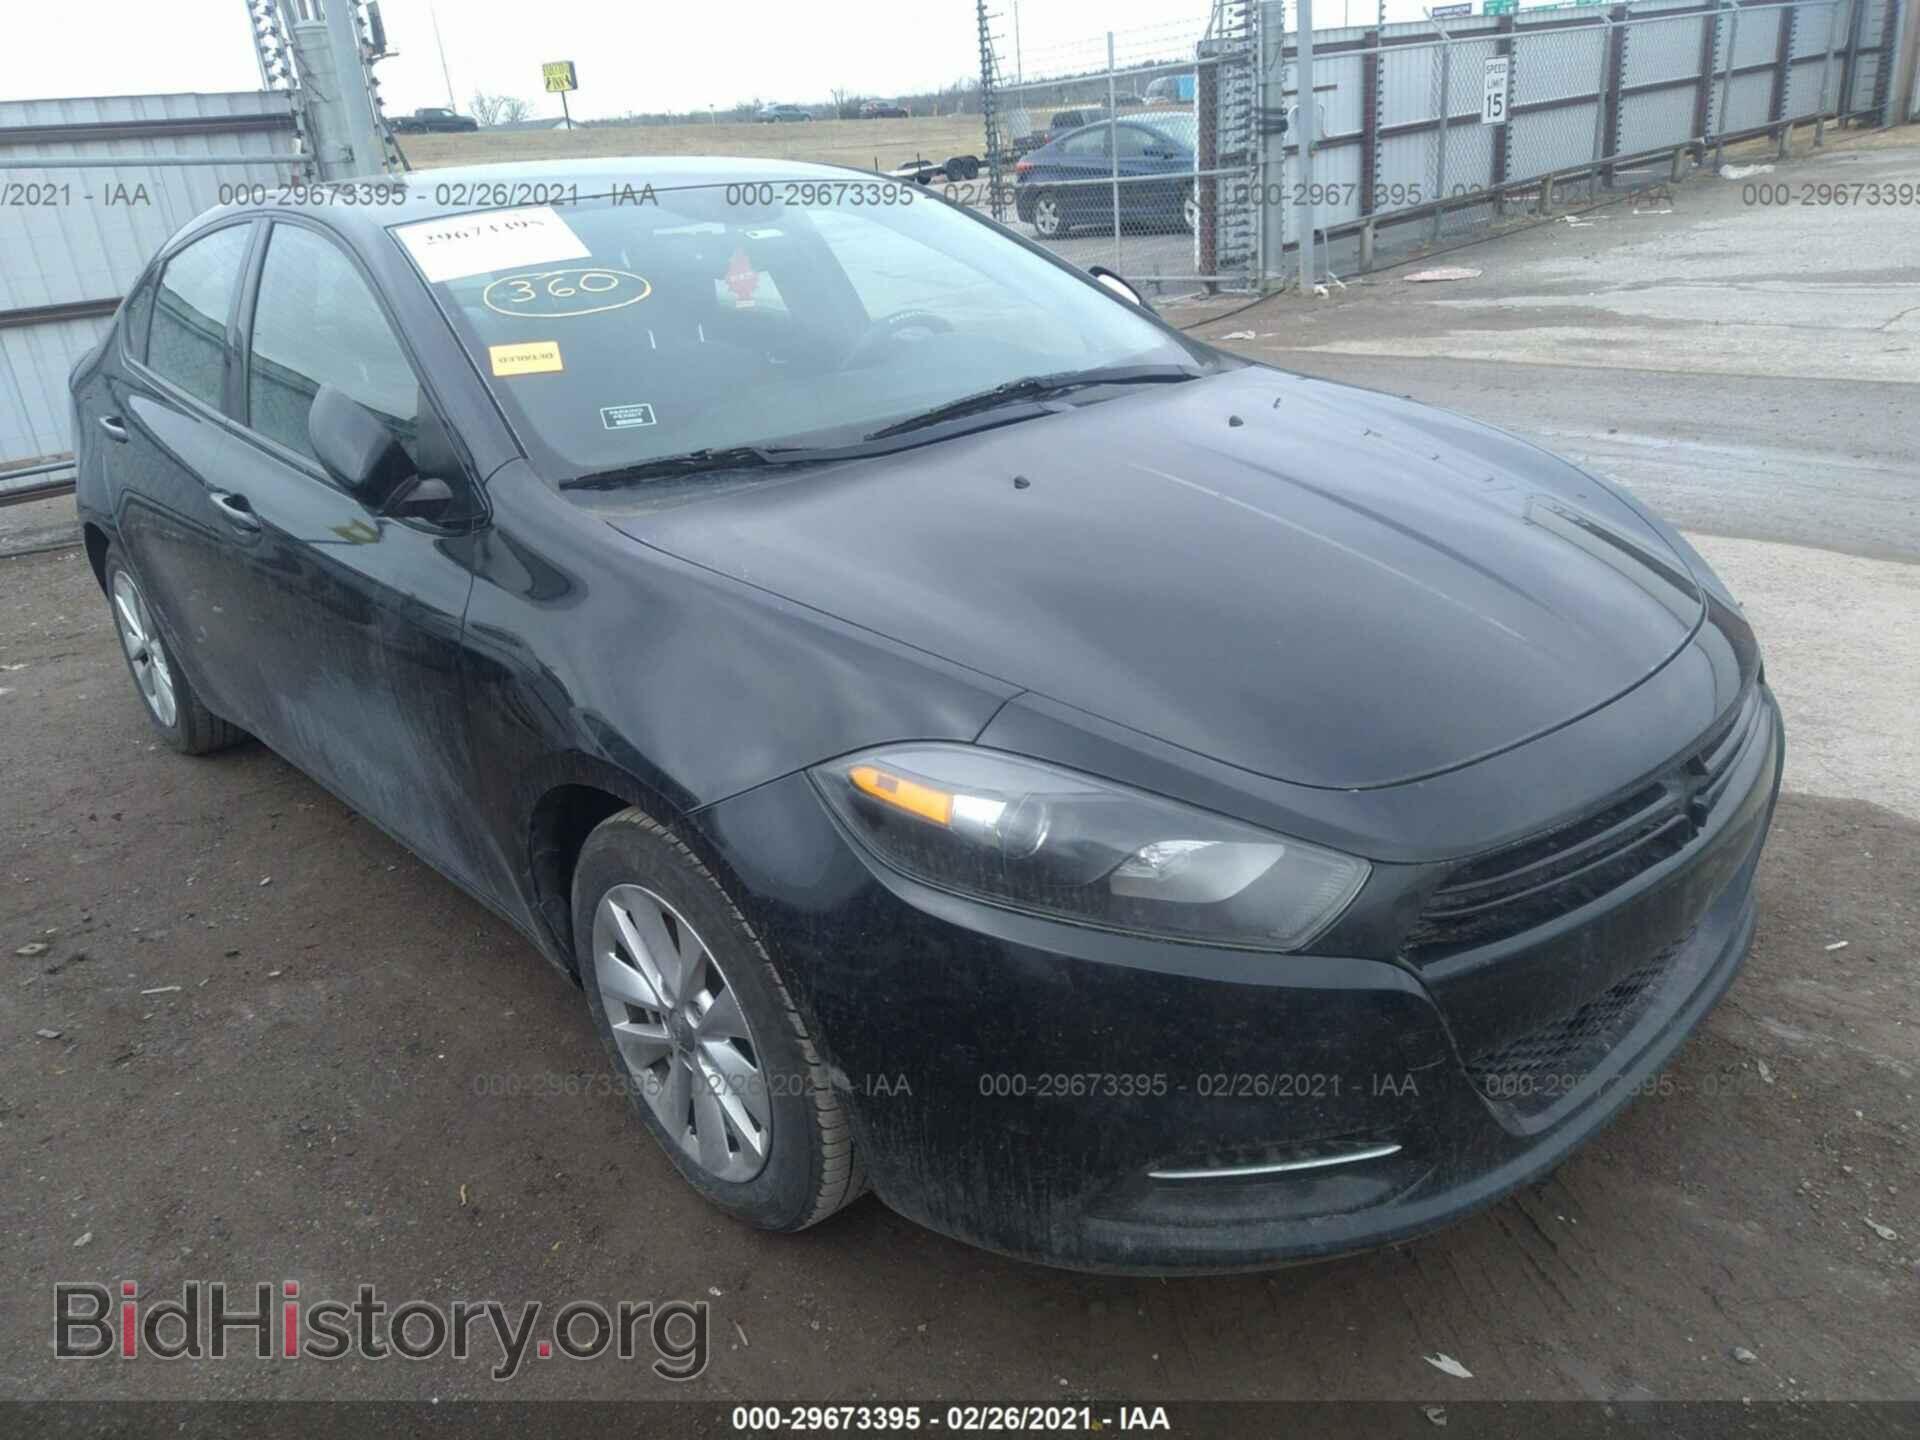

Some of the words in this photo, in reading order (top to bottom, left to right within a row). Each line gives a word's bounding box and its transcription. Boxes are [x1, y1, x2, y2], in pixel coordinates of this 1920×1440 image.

[1486, 63, 1506, 74] SPEED
[1487, 78, 1505, 90] LIMIT
[1486, 93, 1503, 118] 15
[508, 272, 620, 303] 360
